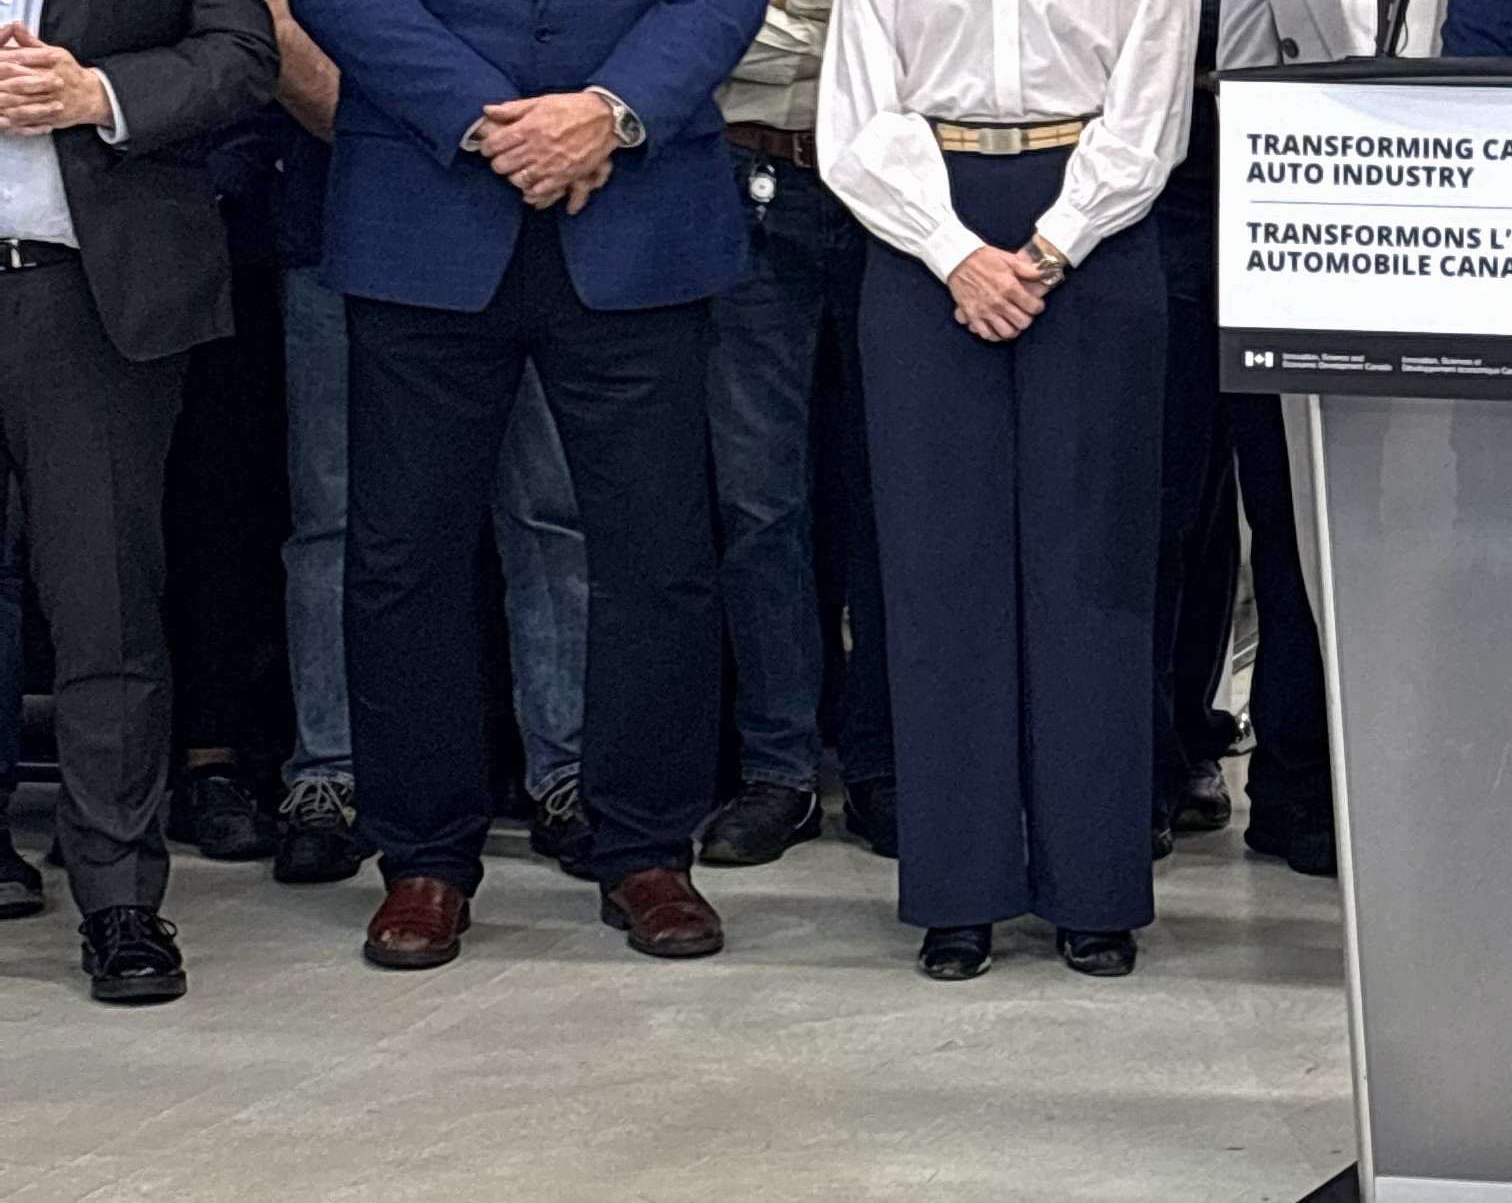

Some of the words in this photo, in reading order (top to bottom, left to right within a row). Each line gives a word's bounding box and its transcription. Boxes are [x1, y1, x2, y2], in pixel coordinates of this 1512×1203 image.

[1247, 133, 1474, 160] TRANSFORMING
[1246, 161, 1324, 184] AUTO
[1333, 163, 1475, 188] INDUSTRY
[1246, 222, 1482, 249] TRANSFORMONS
[1246, 250, 1432, 277] AUTOMOBILE
